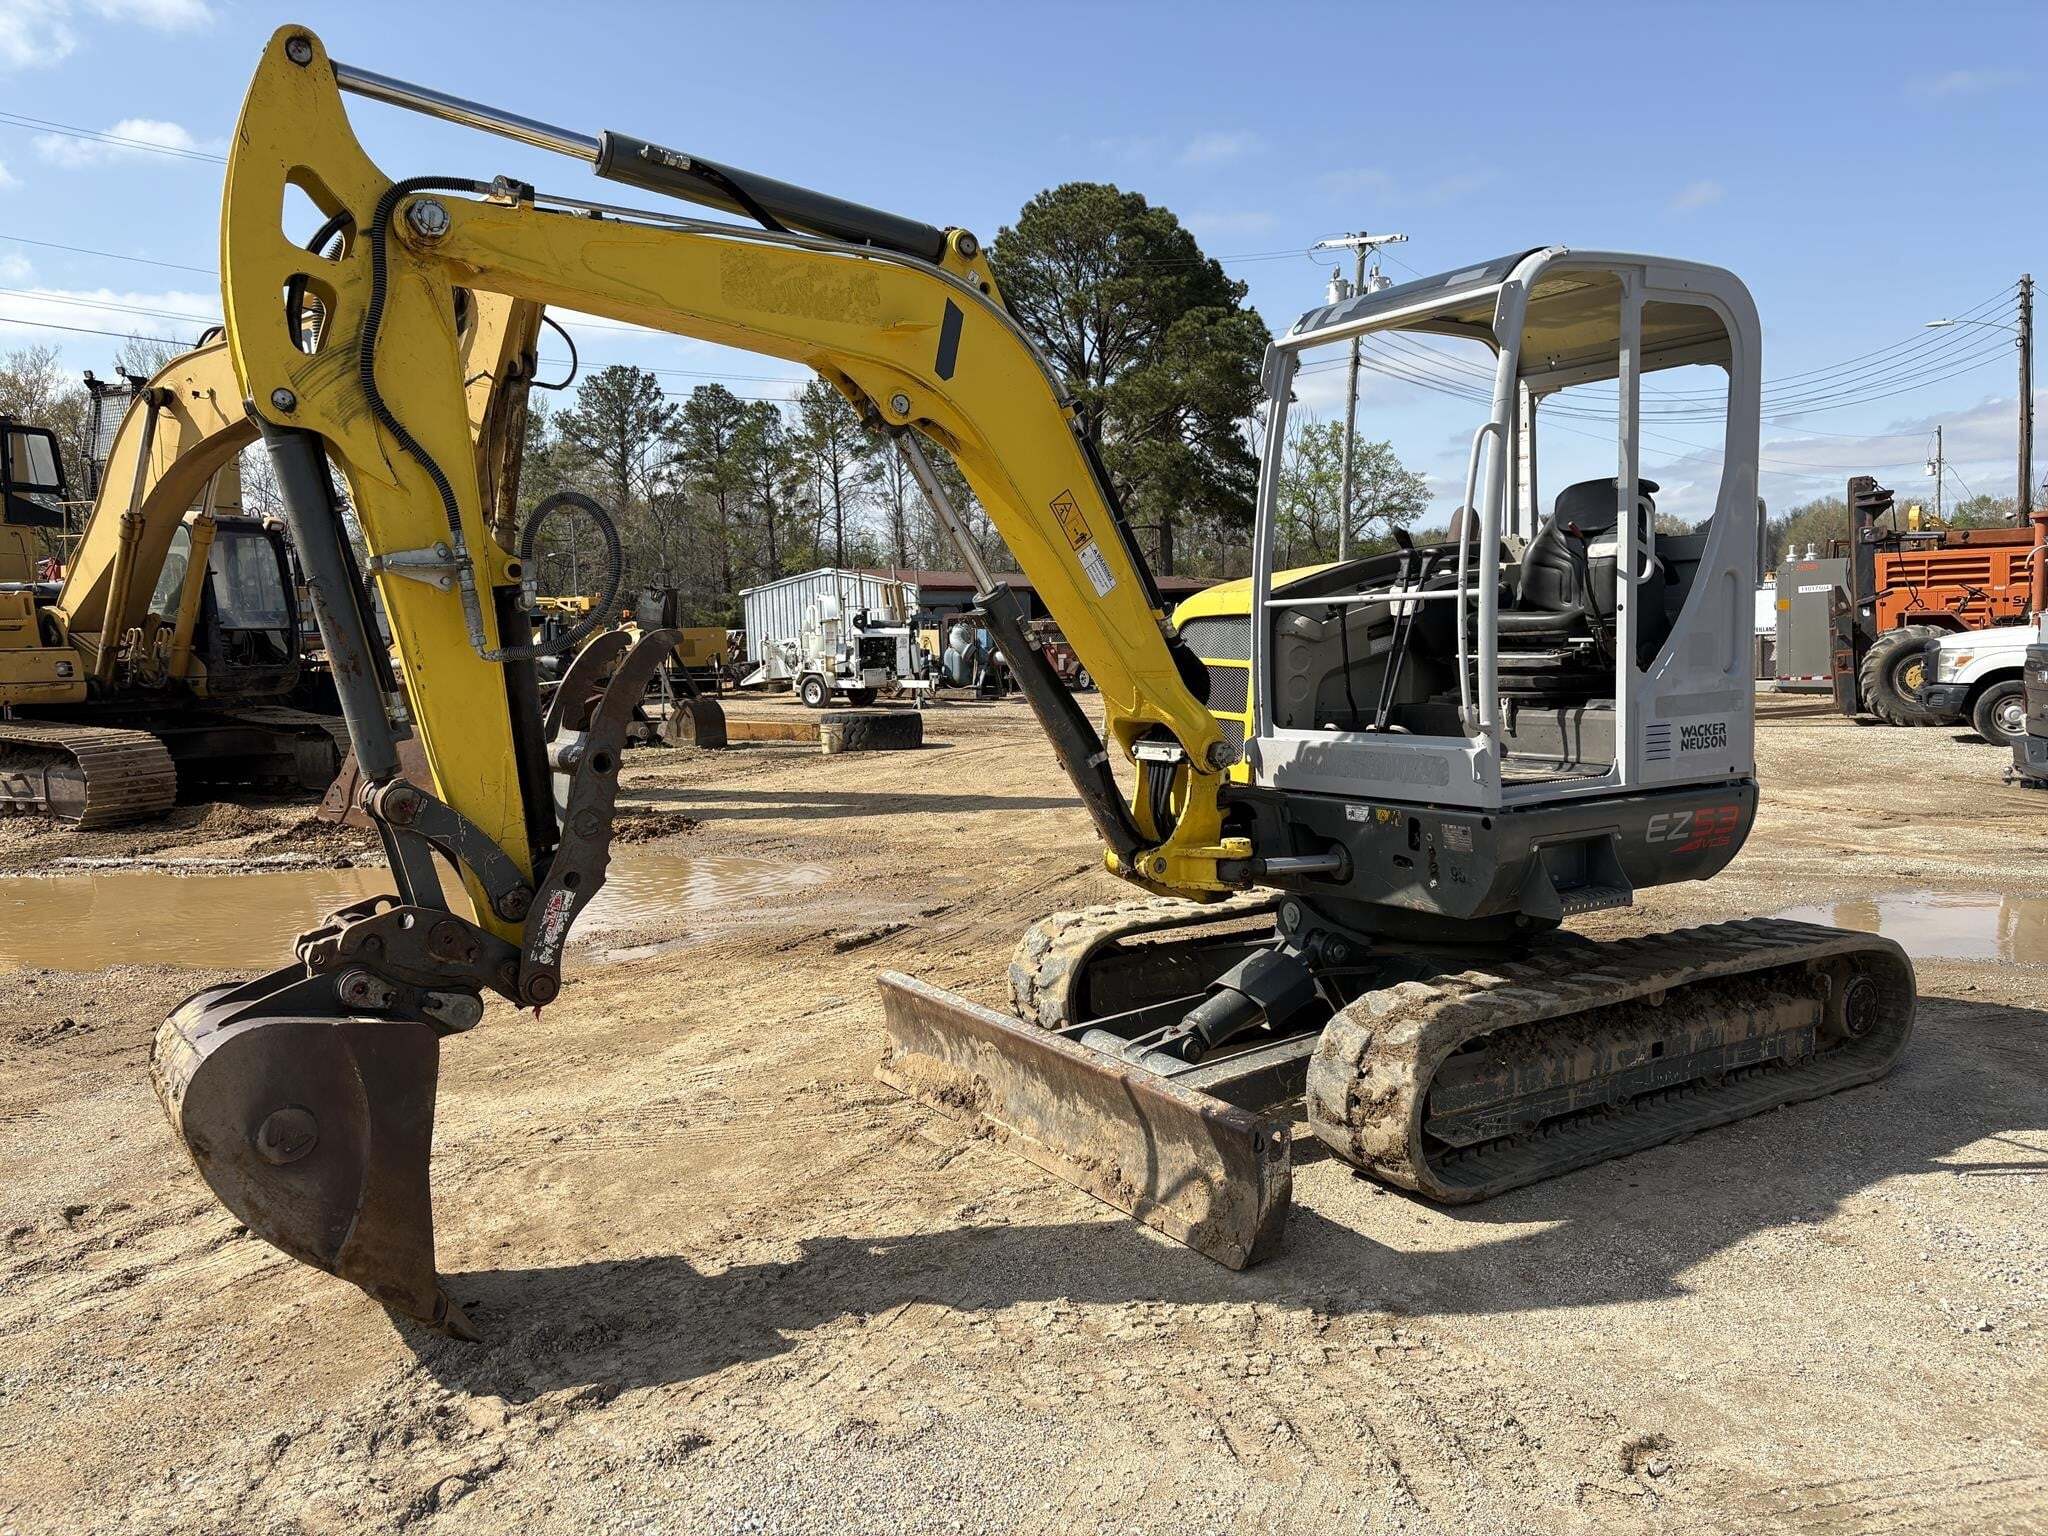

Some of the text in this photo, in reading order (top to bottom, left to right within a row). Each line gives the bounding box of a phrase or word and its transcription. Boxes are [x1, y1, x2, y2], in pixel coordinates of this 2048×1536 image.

[1680, 722, 1726, 738] WACKER
[1681, 735, 1727, 751] NEUSON
[1646, 806, 1739, 842] EZ53
